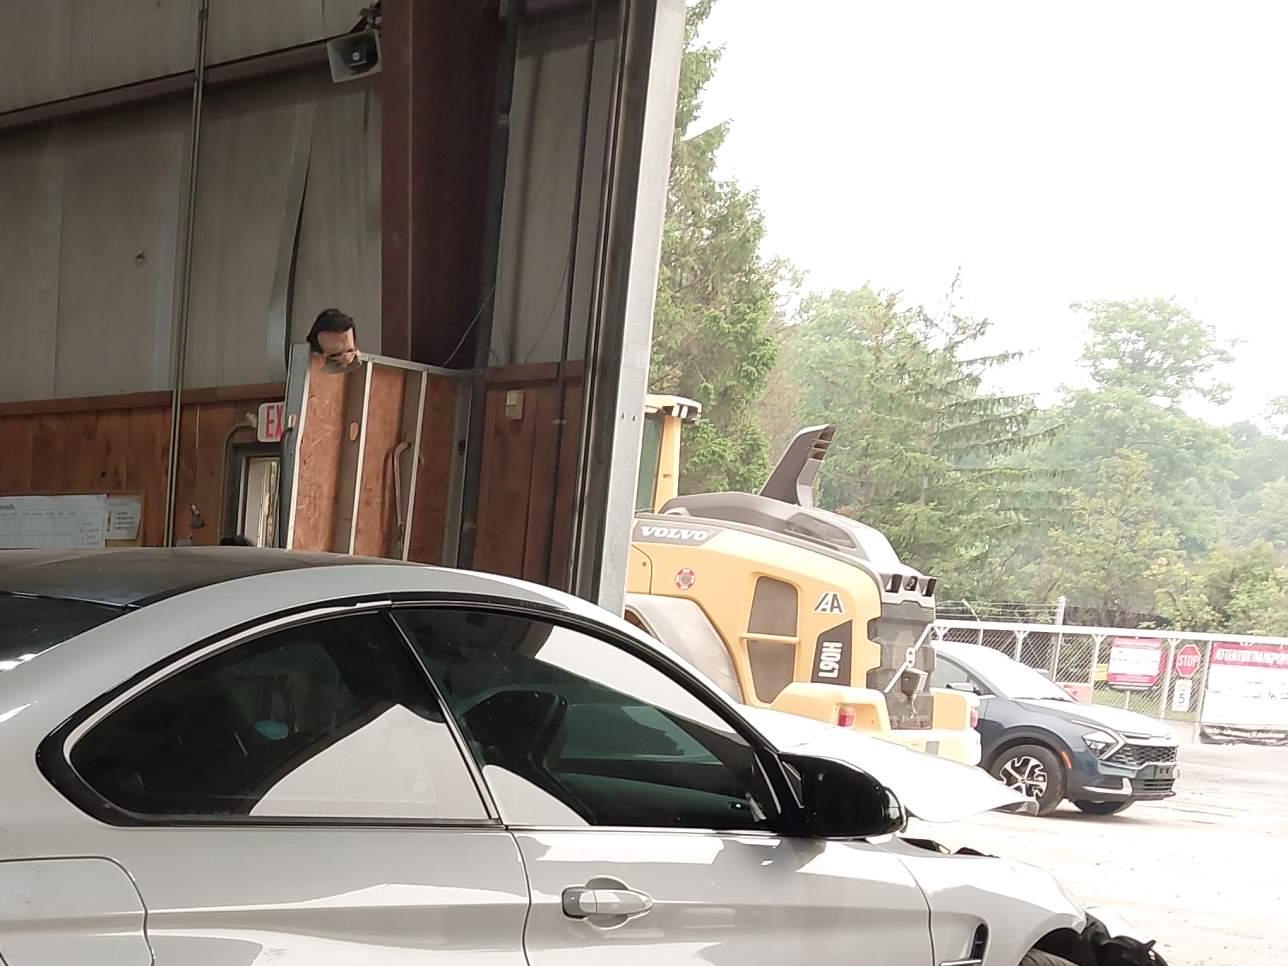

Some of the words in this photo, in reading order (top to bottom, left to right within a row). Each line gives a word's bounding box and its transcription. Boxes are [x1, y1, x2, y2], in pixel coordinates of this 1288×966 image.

[640, 526, 709, 540] VOLVO
[818, 641, 843, 678] L90H
[1177, 654, 1199, 667] STOP
[1178, 693, 1185, 704] 5
